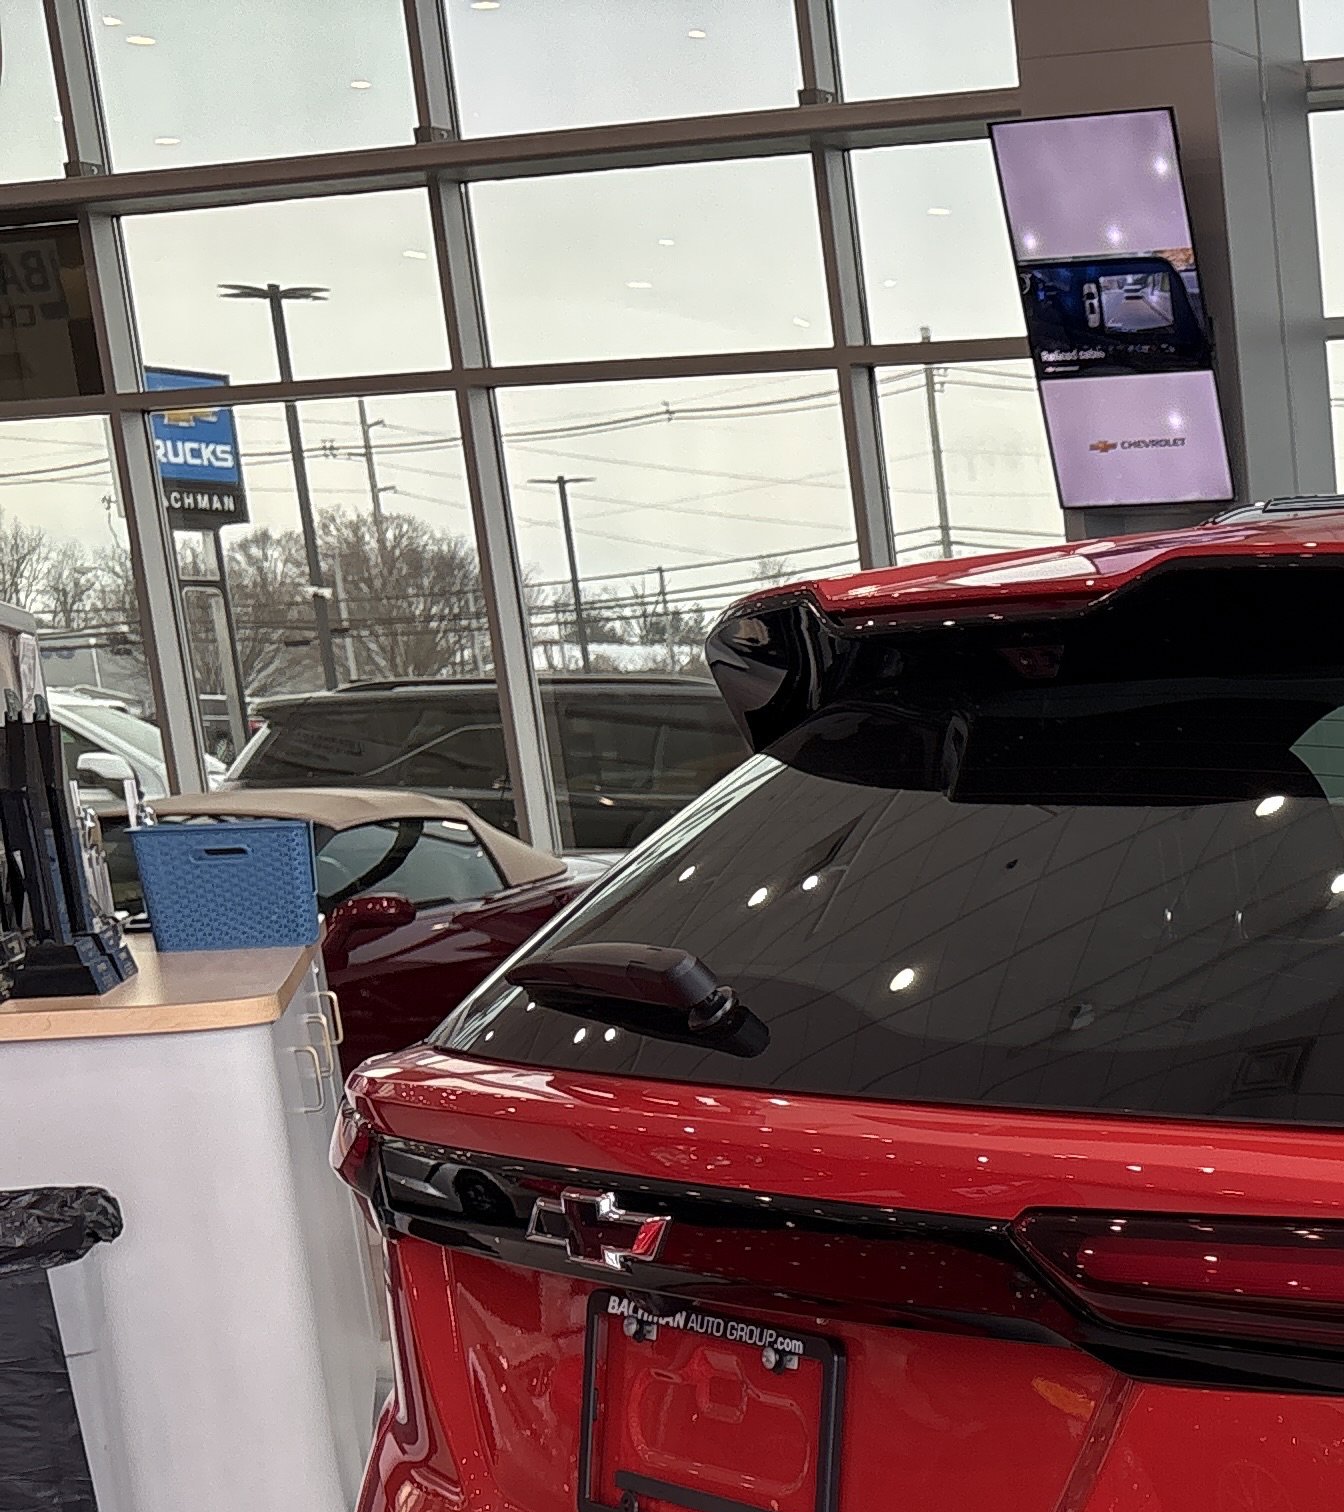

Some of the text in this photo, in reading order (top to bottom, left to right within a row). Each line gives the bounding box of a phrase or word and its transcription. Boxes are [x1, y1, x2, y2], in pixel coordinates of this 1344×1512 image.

[1120, 438, 1186, 450] CHEVROLET
[687, 1315, 724, 1337] AUTO
[727, 1321, 804, 1355] GROUP.com
